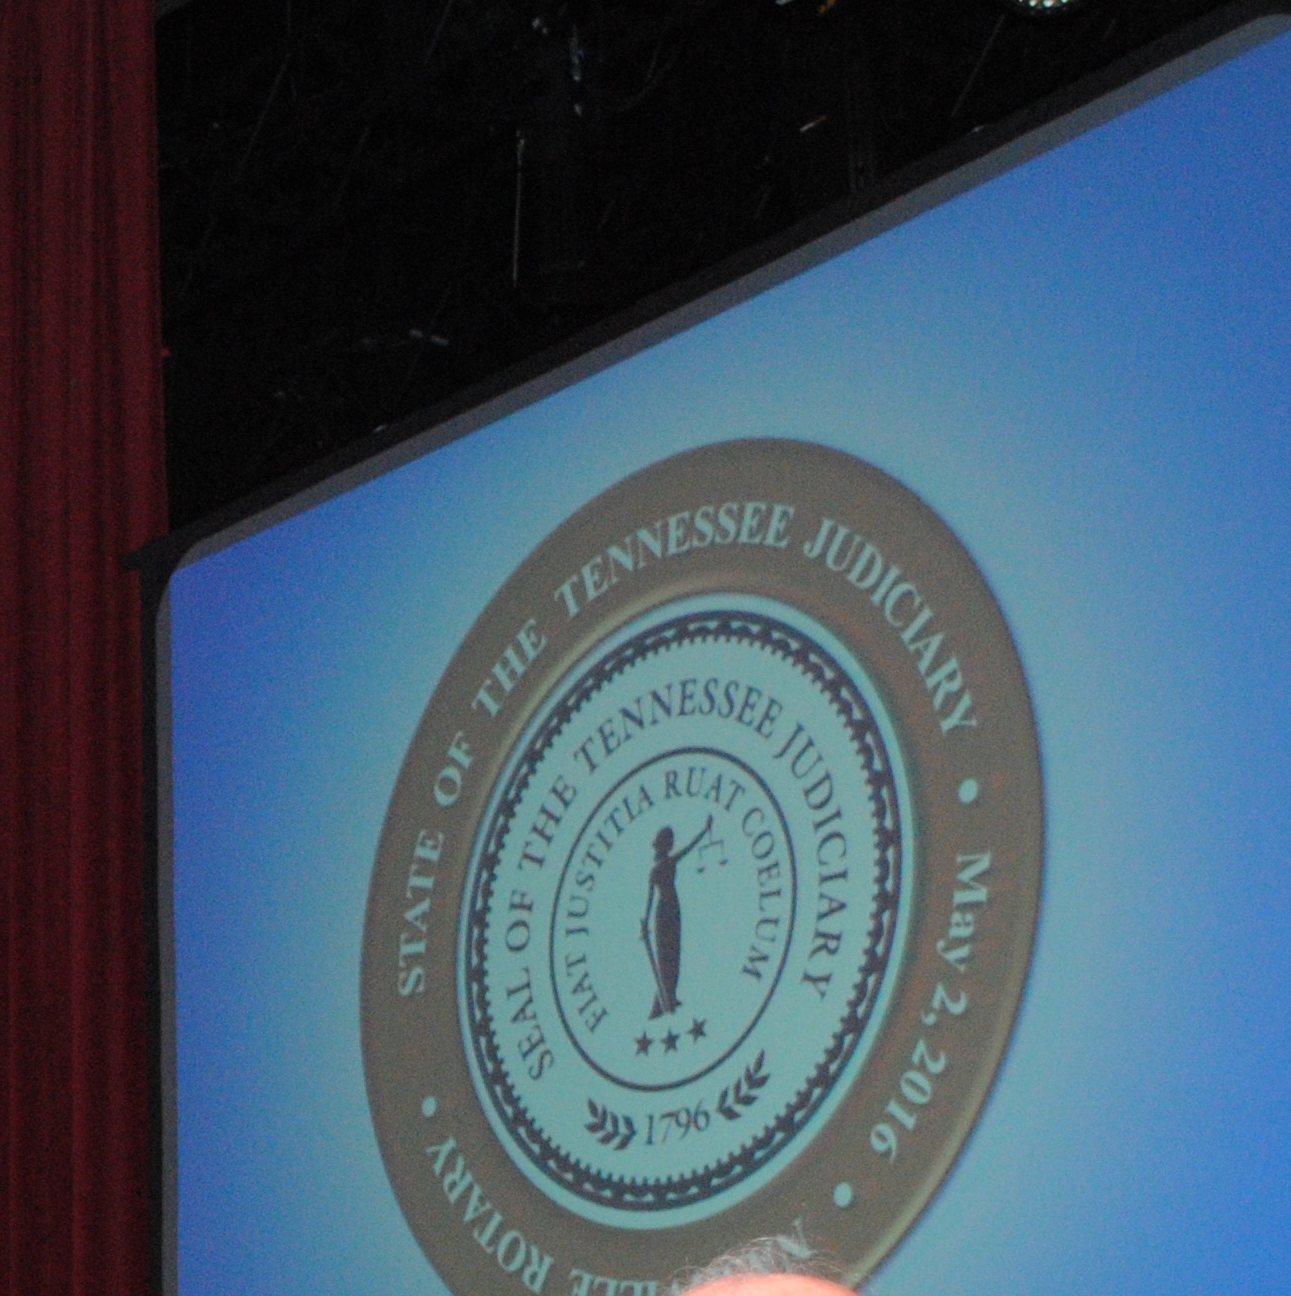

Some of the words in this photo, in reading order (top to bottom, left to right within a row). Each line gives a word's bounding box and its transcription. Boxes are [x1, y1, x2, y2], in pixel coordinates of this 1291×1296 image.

[398, 829, 445, 997] STATE
[433, 731, 479, 809] OF
[471, 619, 550, 721] THE
[554, 502, 796, 620] TENNESSEE
[803, 517, 978, 736] JUDICIARY
[573, 677, 784, 775] TENNESSEE
[519, 774, 578, 870] THE
[664, 766, 746, 812] RUAT
[565, 784, 656, 938] JUSTITIA
[741, 807, 782, 983] COELUM
[773, 722, 849, 1000] JUDICIARY
[936, 852, 993, 974] May
[505, 891, 534, 954] OF
[506, 967, 555, 1081] SEAL
[565, 953, 609, 1034] FIAT
[921, 982, 967, 1026] 2,
[644, 1101, 712, 1146] 1796
[869, 1038, 947, 1164] 2016
[425, 1137, 556, 1295] ROTARY
